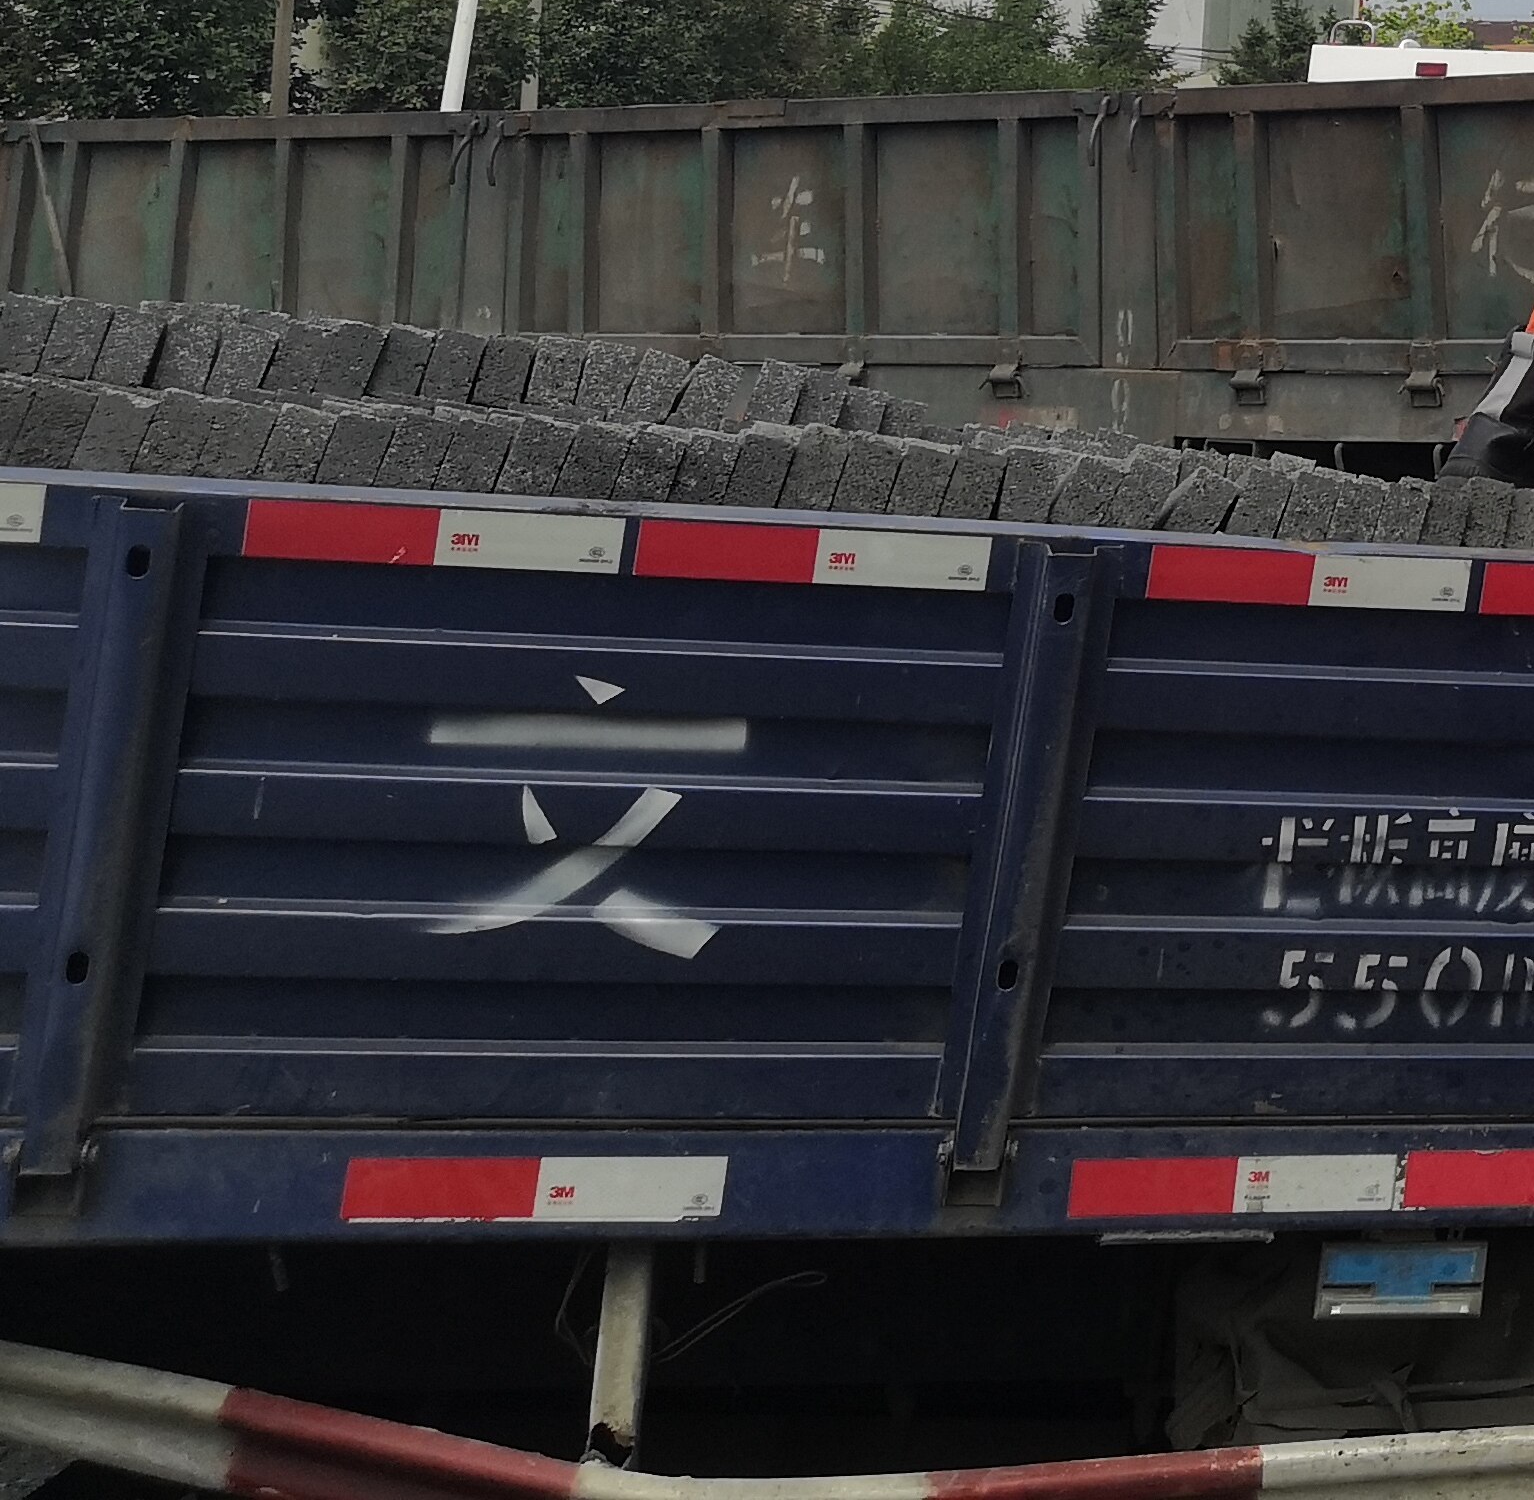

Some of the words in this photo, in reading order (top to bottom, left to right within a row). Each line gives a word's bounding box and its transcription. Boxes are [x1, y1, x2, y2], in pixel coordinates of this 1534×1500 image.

[424, 674, 748, 960] 文
[1248, 1171, 1271, 1183] 3M
[549, 1185, 575, 1199] 3M
